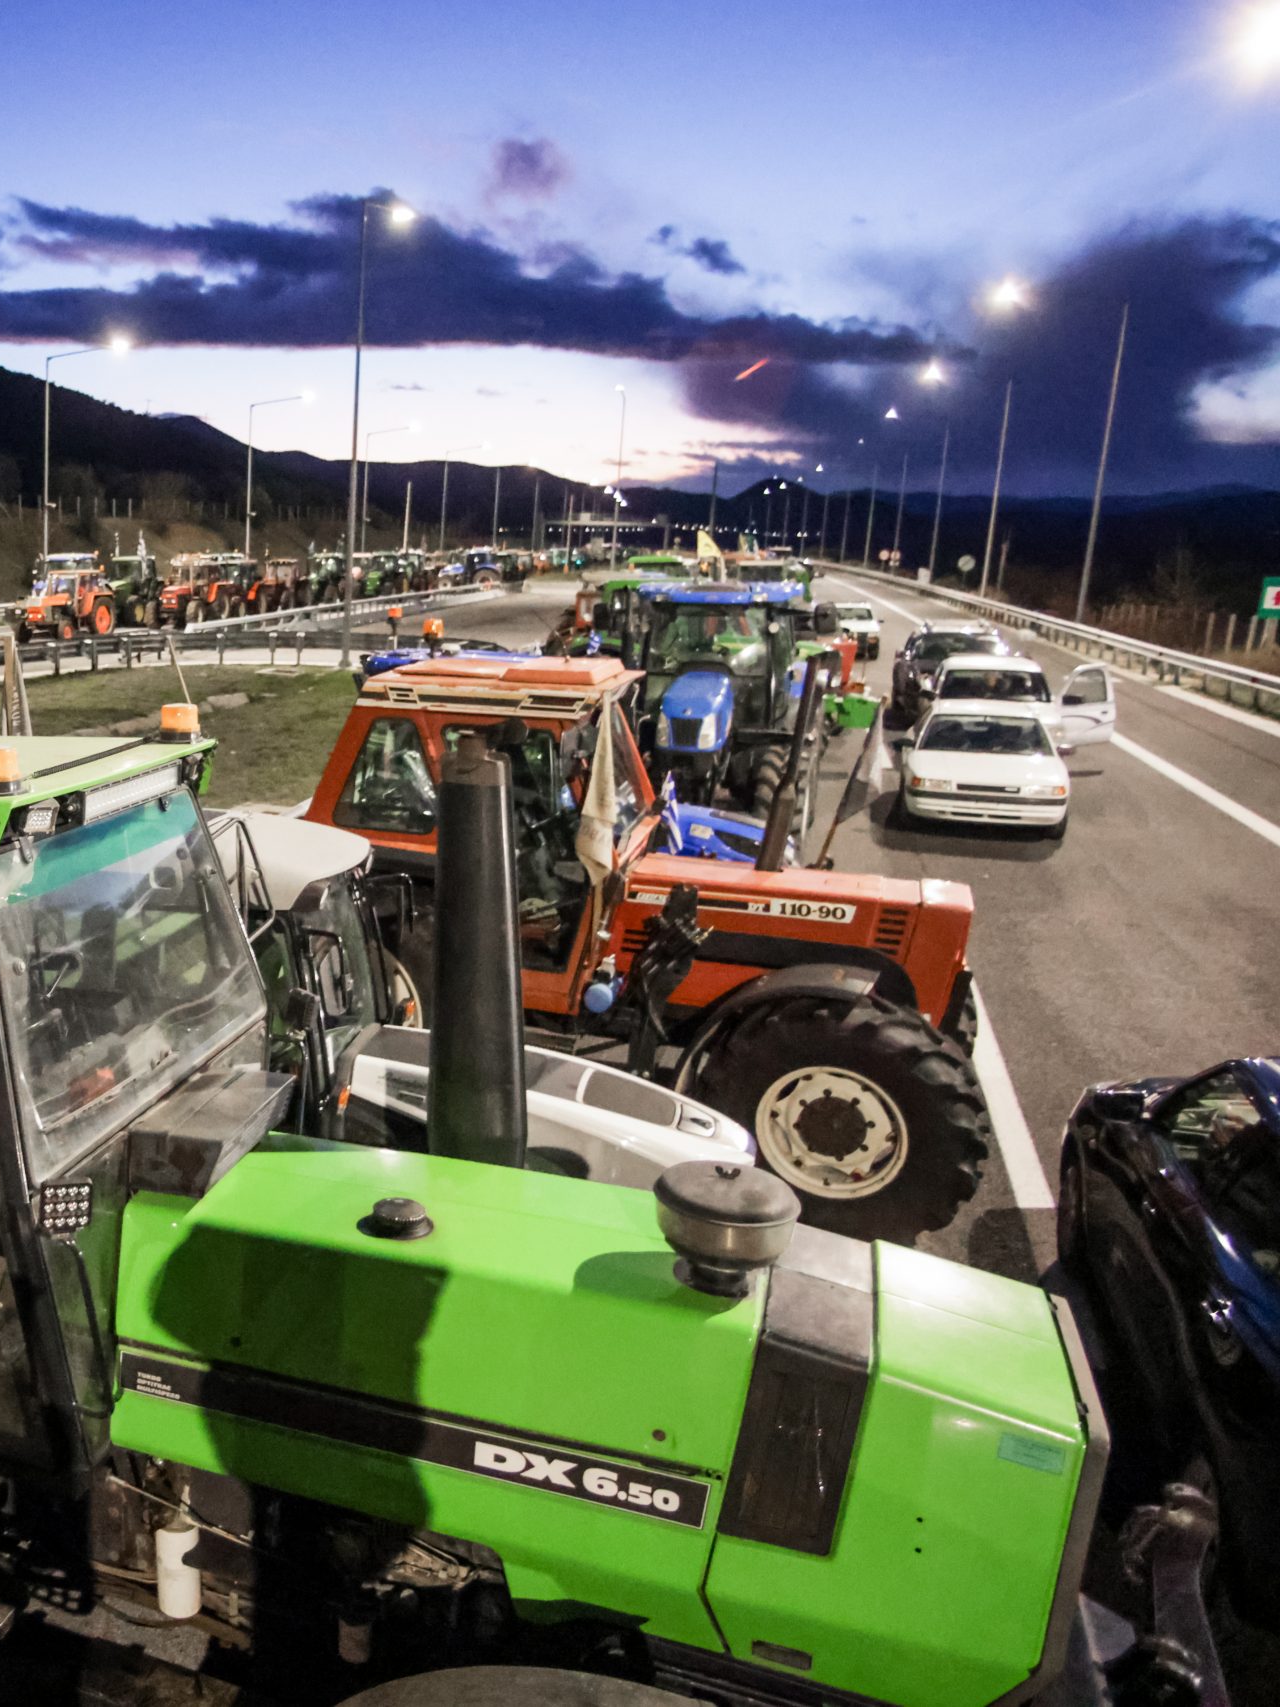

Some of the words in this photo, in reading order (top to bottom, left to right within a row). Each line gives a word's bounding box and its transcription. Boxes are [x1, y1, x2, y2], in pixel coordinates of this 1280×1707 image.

[779, 902, 846, 920] 110-90
[474, 1441, 578, 1488] DX
[582, 1467, 680, 1512] 6.50
